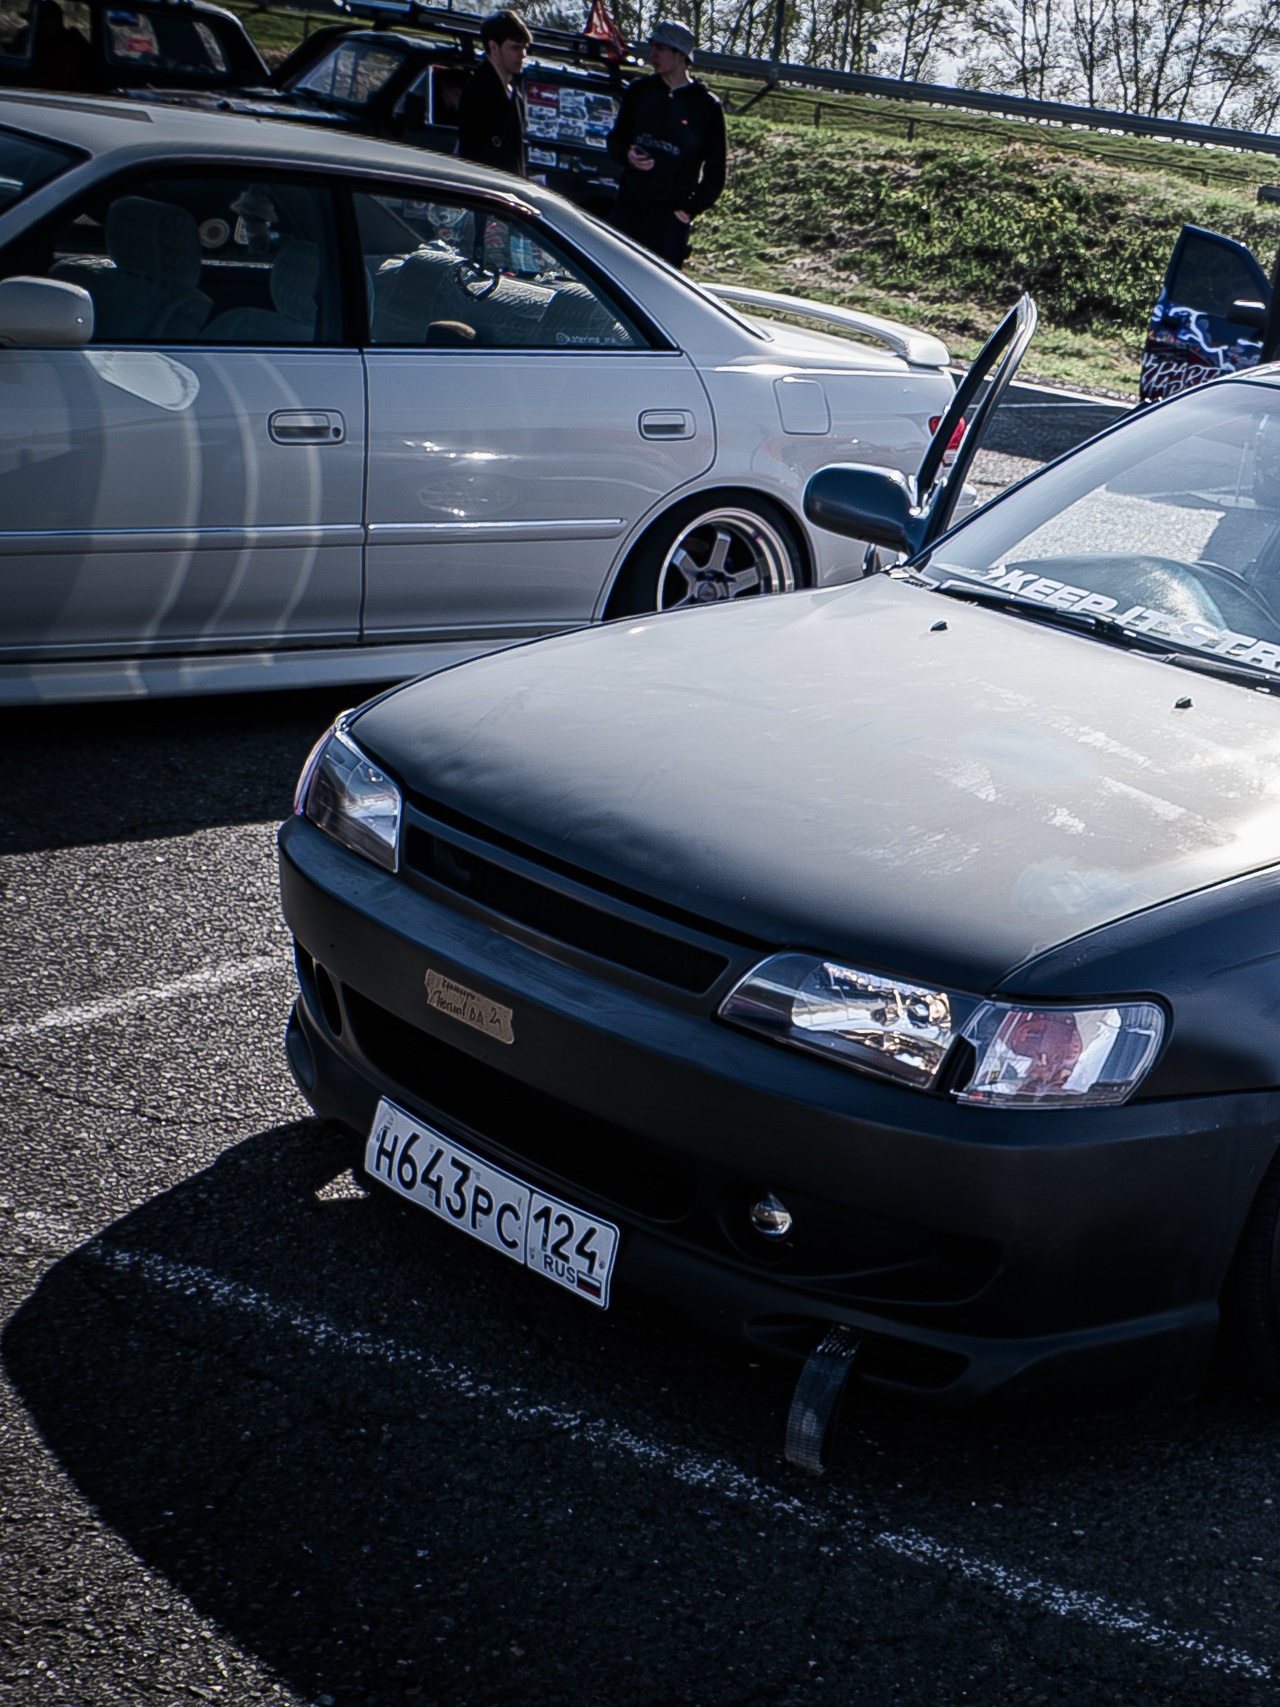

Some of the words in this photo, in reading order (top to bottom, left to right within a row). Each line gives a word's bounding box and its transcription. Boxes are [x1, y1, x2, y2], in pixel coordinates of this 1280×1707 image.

[999, 568, 1119, 613] KEEP
[1113, 605, 1177, 632] IT
[532, 1205, 598, 1275] 124
[543, 1253, 577, 1284] RUS
